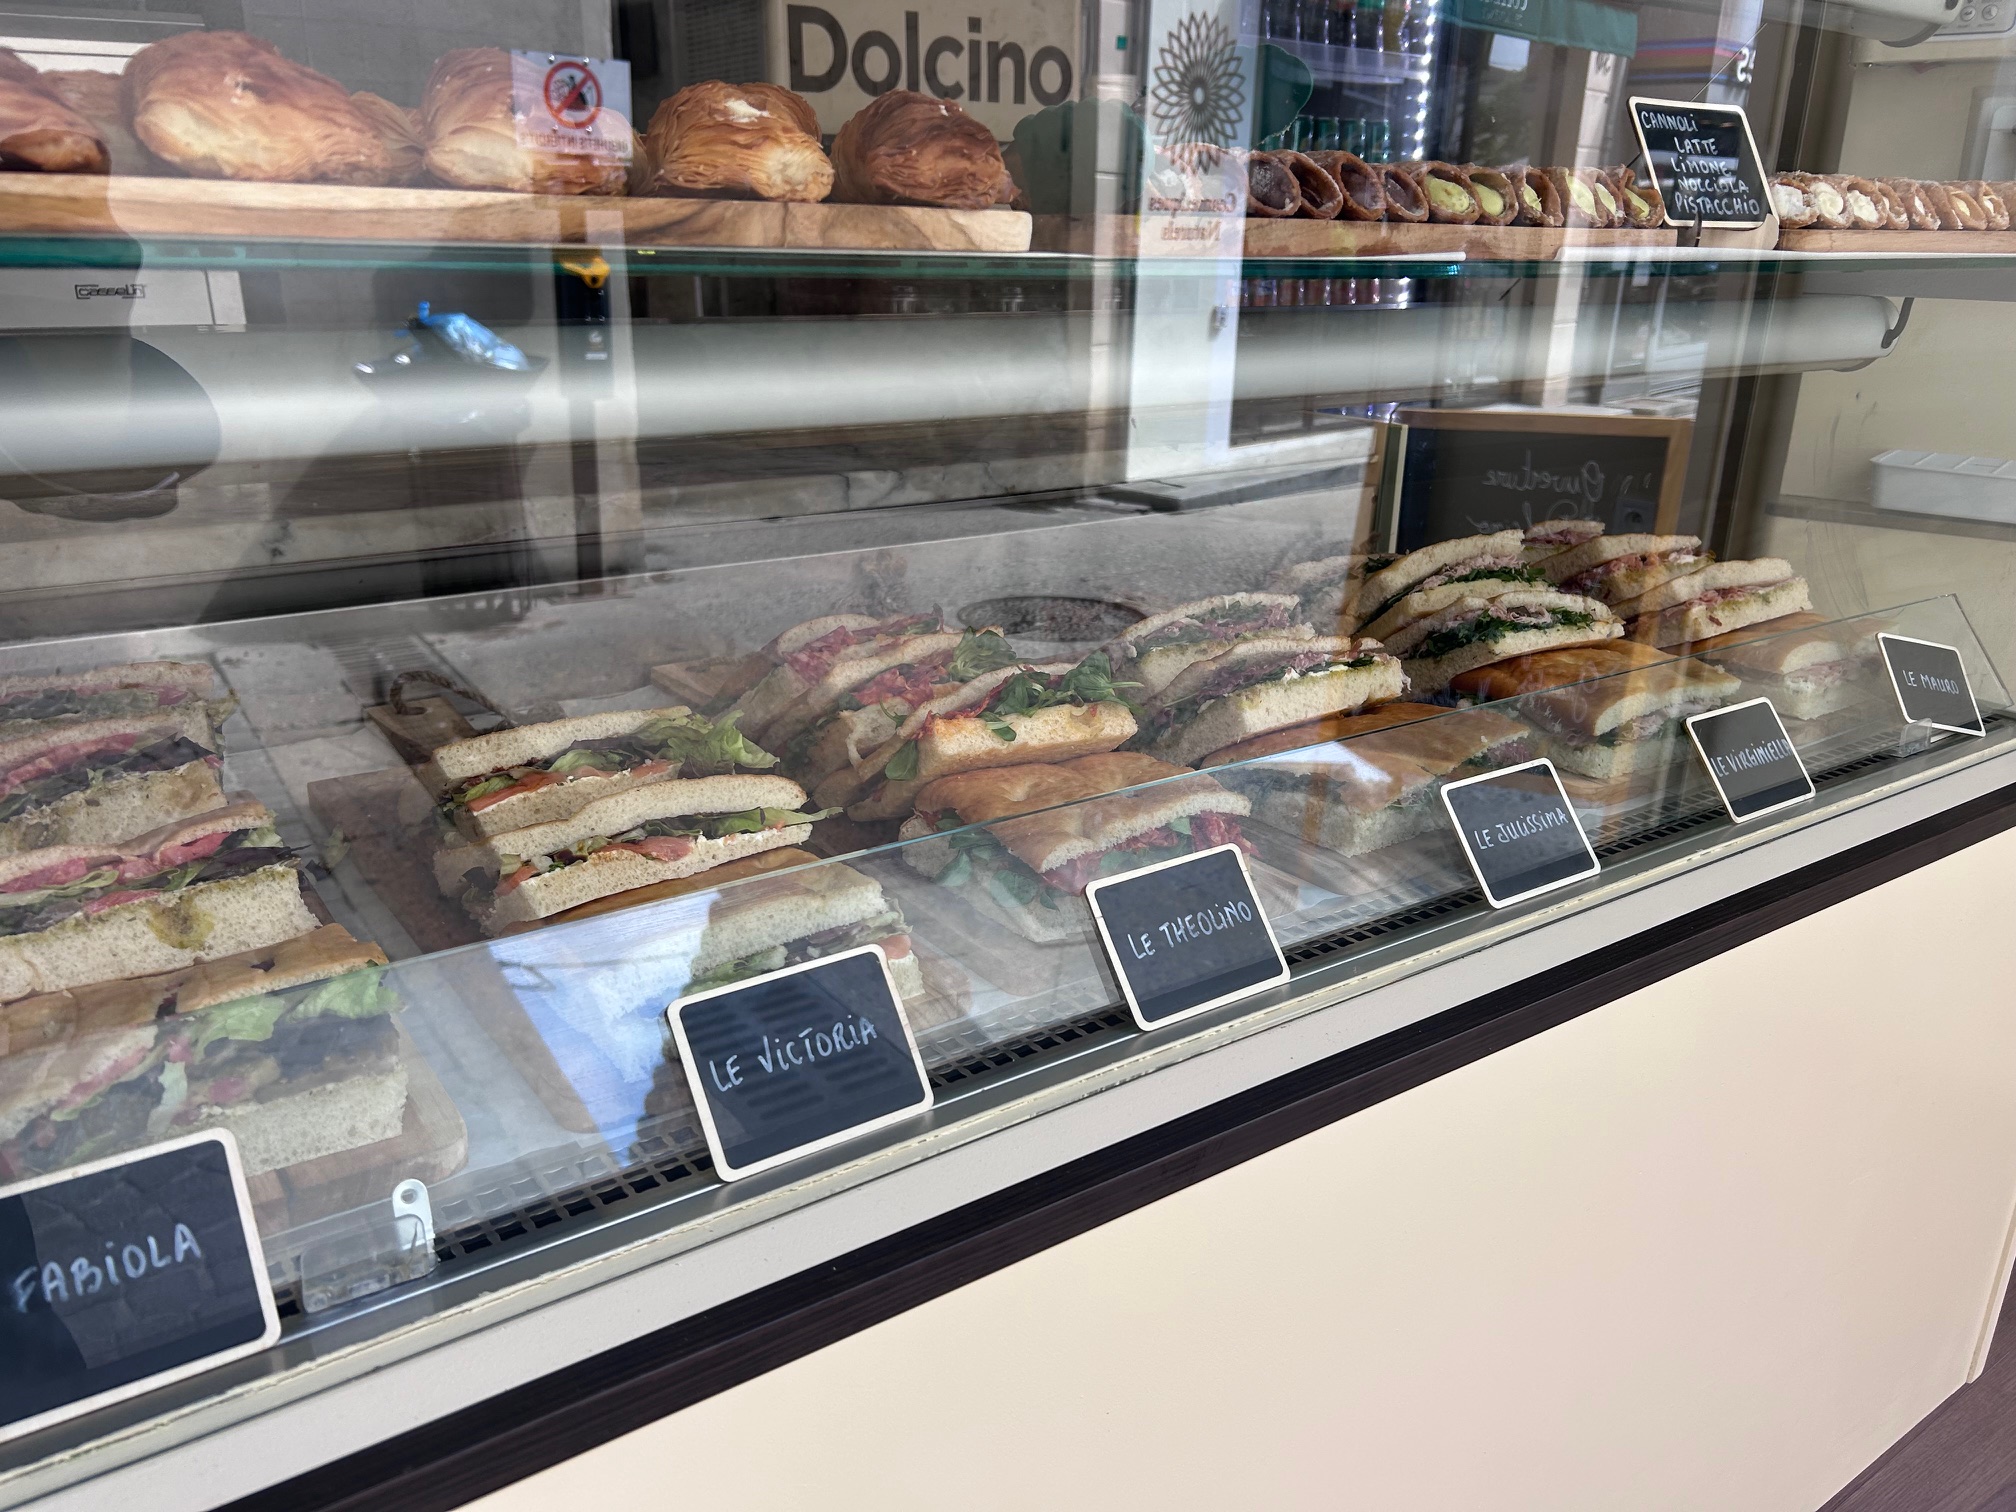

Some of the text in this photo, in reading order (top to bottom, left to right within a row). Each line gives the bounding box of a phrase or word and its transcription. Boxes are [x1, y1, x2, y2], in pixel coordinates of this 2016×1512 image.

[787, 4, 1073, 106] Dolcino
[1674, 136, 1719, 155] LATTE
[1902, 669, 1960, 695] LE MAURO
[1710, 756, 1730, 778] LE
[1474, 829, 1495, 850] LE
[1127, 932, 1156, 960] LE
[709, 1054, 744, 1092] LE
